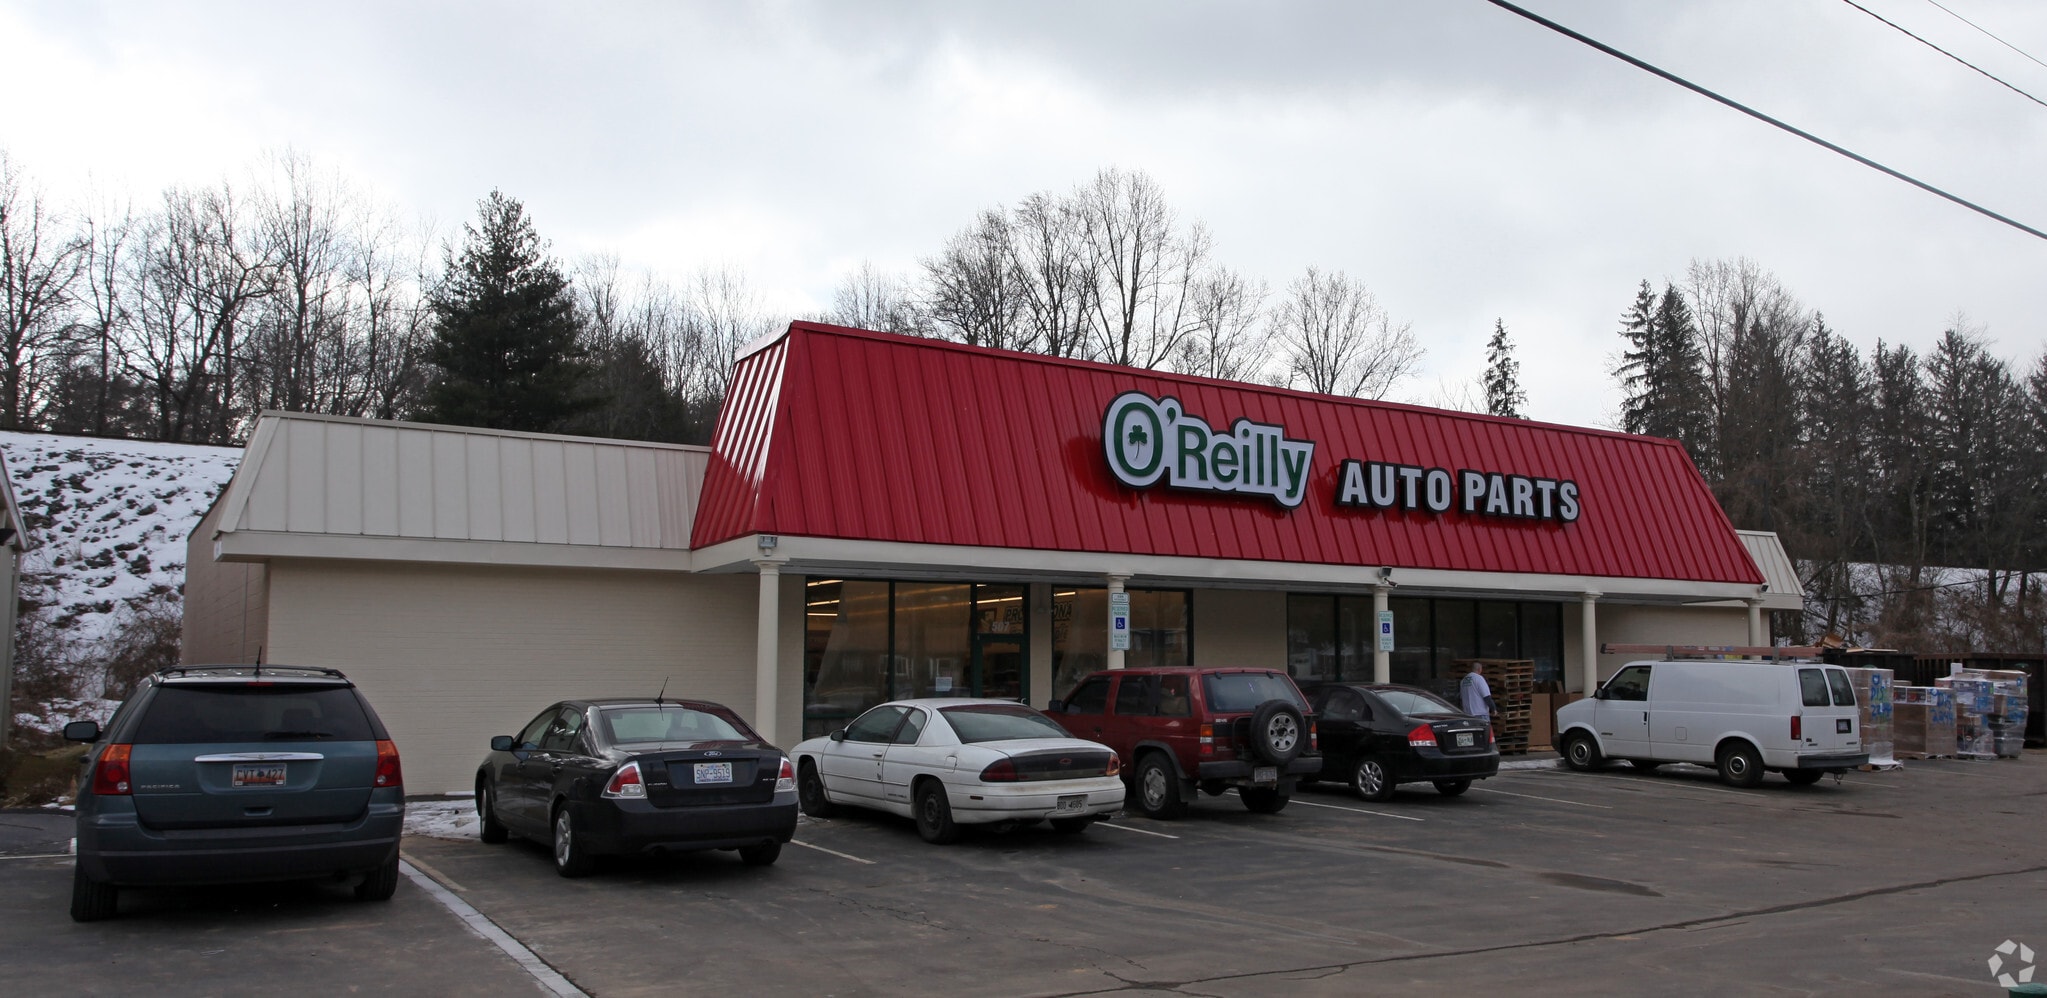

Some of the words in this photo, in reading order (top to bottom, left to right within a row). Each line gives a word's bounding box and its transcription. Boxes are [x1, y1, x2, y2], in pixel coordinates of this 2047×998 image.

[1114, 402, 1307, 498] O'Reilly
[1341, 461, 1451, 512] AUTO
[1464, 472, 1580, 521] PARTS
